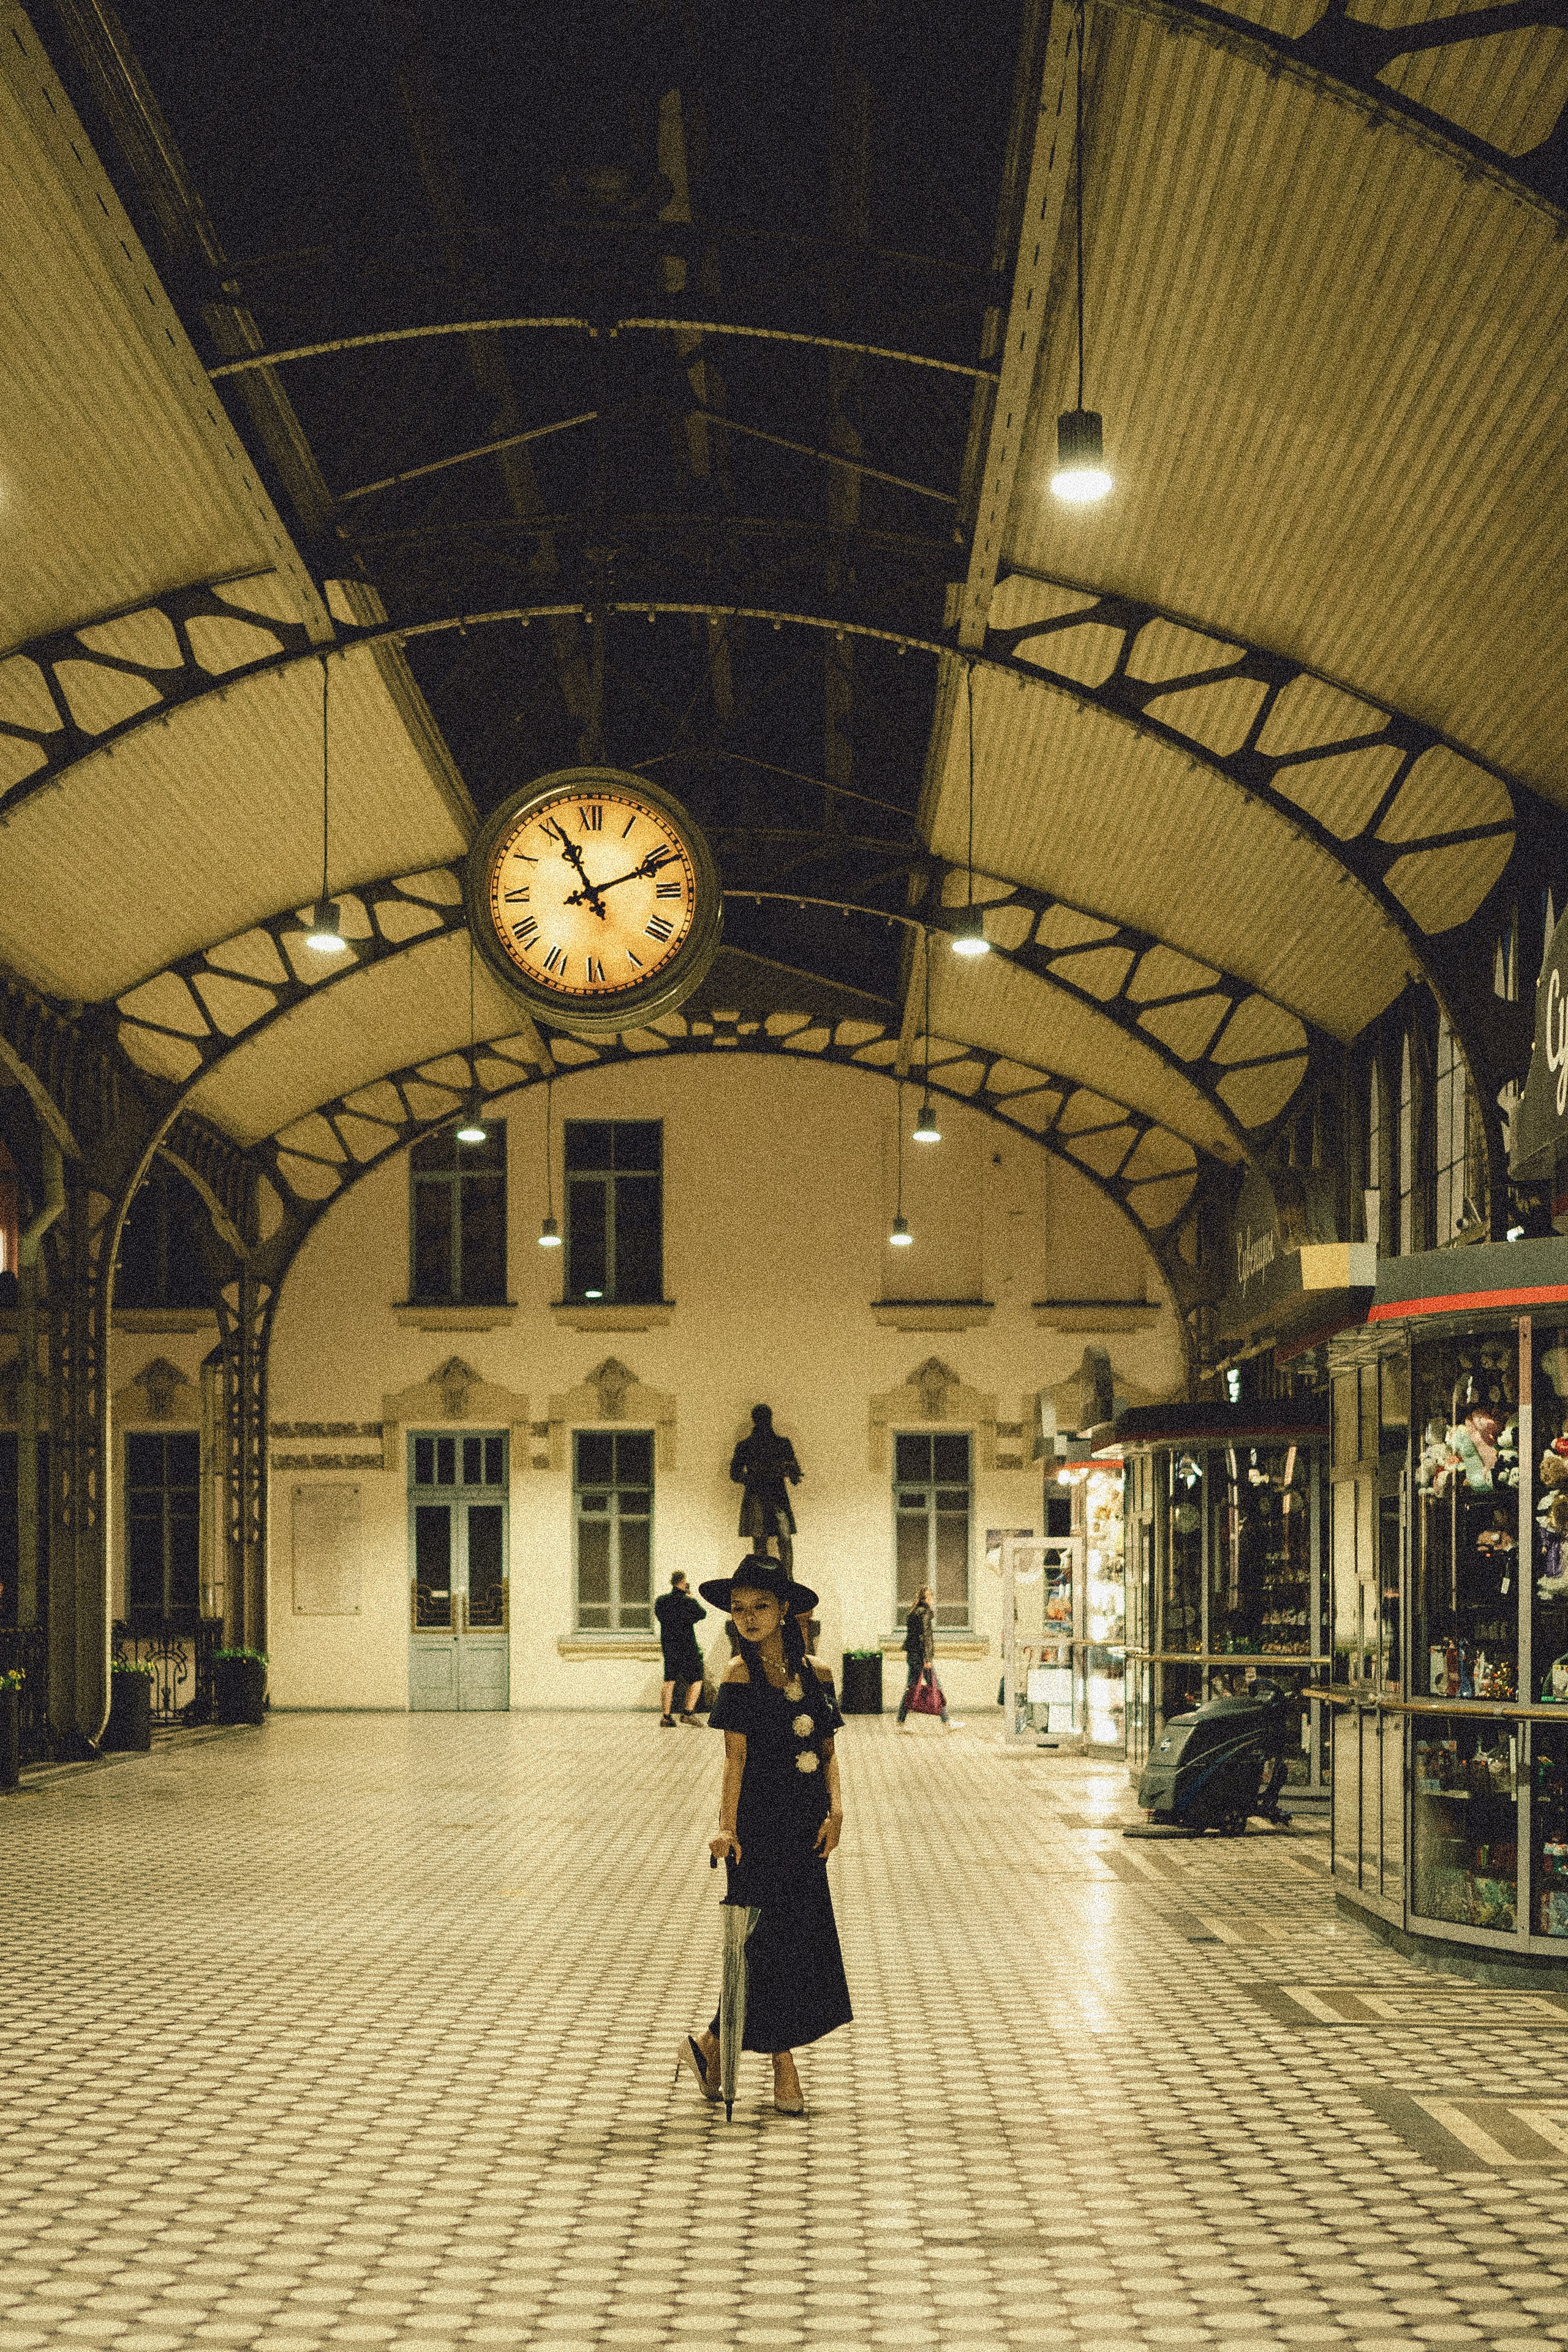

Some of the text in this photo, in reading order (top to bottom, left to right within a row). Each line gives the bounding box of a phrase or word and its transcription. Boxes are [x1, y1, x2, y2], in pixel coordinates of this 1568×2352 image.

[578, 805, 603, 832] XII
[622, 815, 636, 839] I
[513, 847, 539, 870] X
[504, 886, 530, 903] IX
[655, 882, 681, 899] III
[512, 915, 541, 951] VIII
[644, 914, 674, 943] IIII
[543, 945, 568, 977] VII
[586, 956, 606, 983] VI
[625, 946, 643, 972] V
